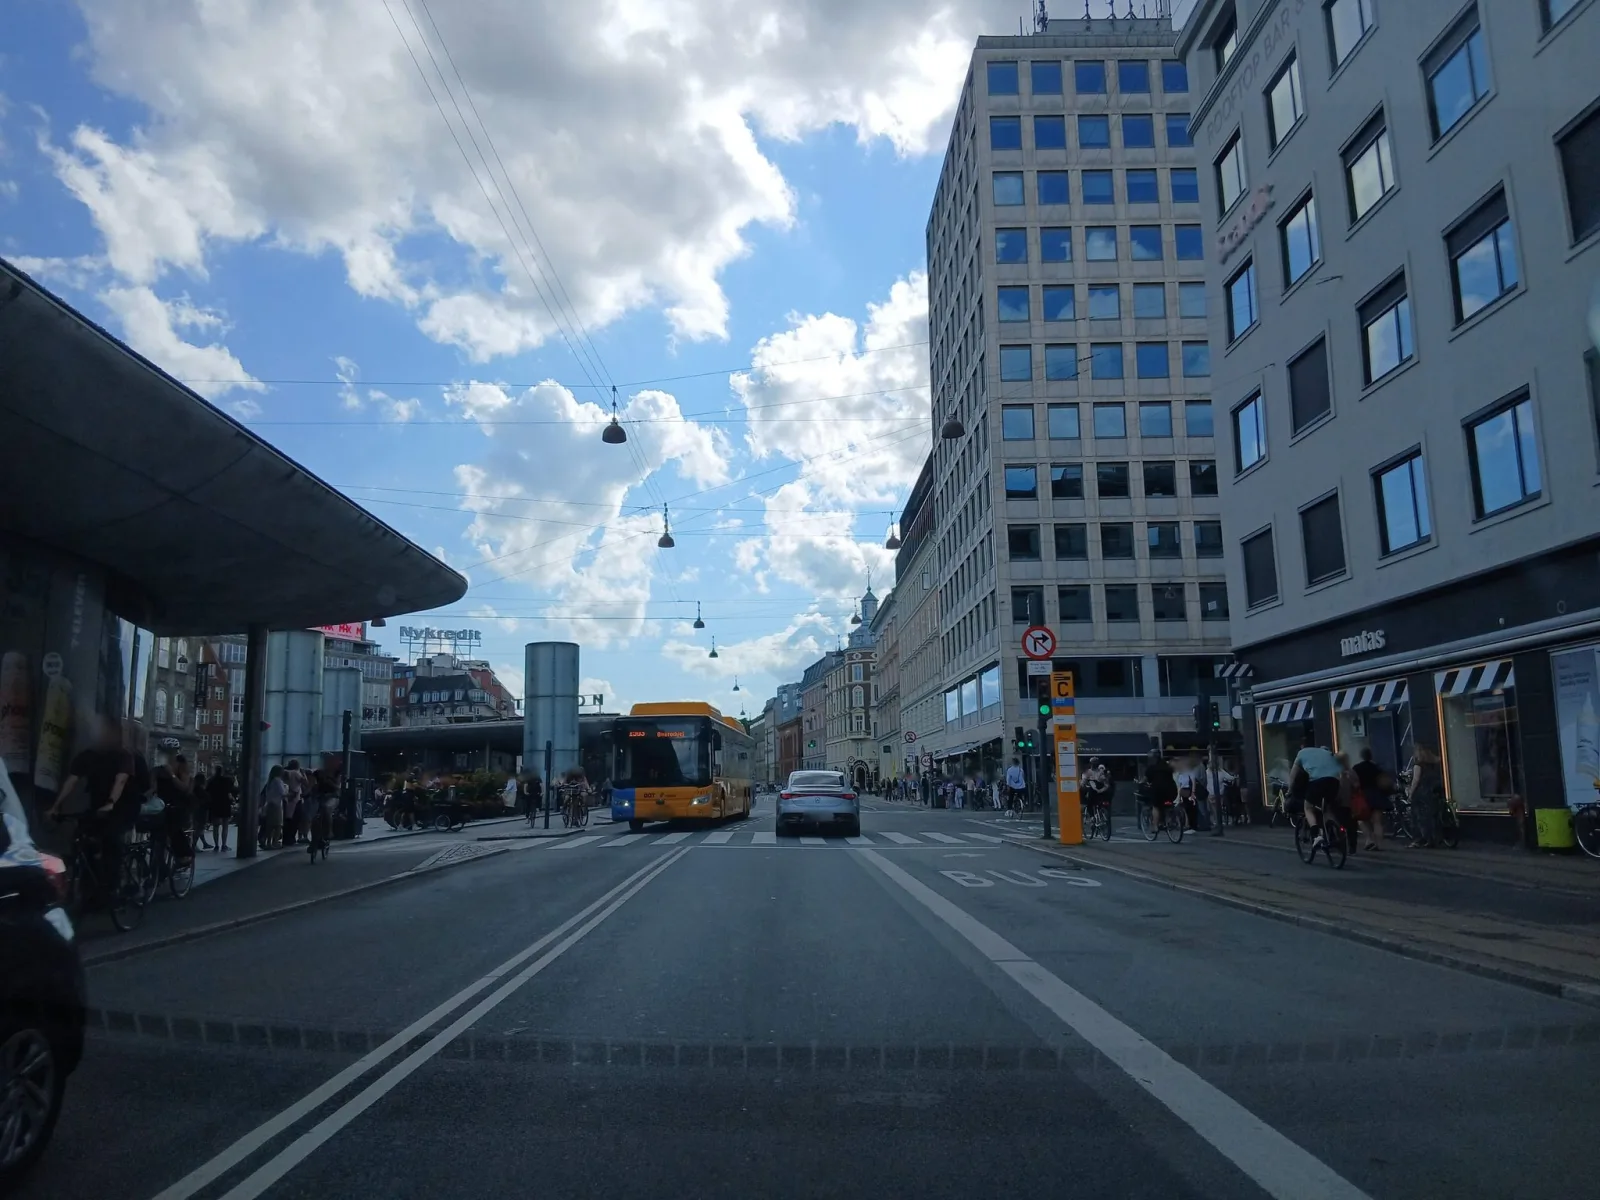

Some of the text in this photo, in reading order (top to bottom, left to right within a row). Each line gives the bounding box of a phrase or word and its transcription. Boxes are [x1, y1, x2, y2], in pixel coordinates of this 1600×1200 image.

[1207, 52, 1261, 142] ROOFTOP
[1264, 7, 1290, 62] BAR
[399, 626, 482, 641] Nykredit
[1340, 629, 1386, 657] matas
[1057, 681, 1070, 697] C
[938, 869, 1102, 888] BUS
